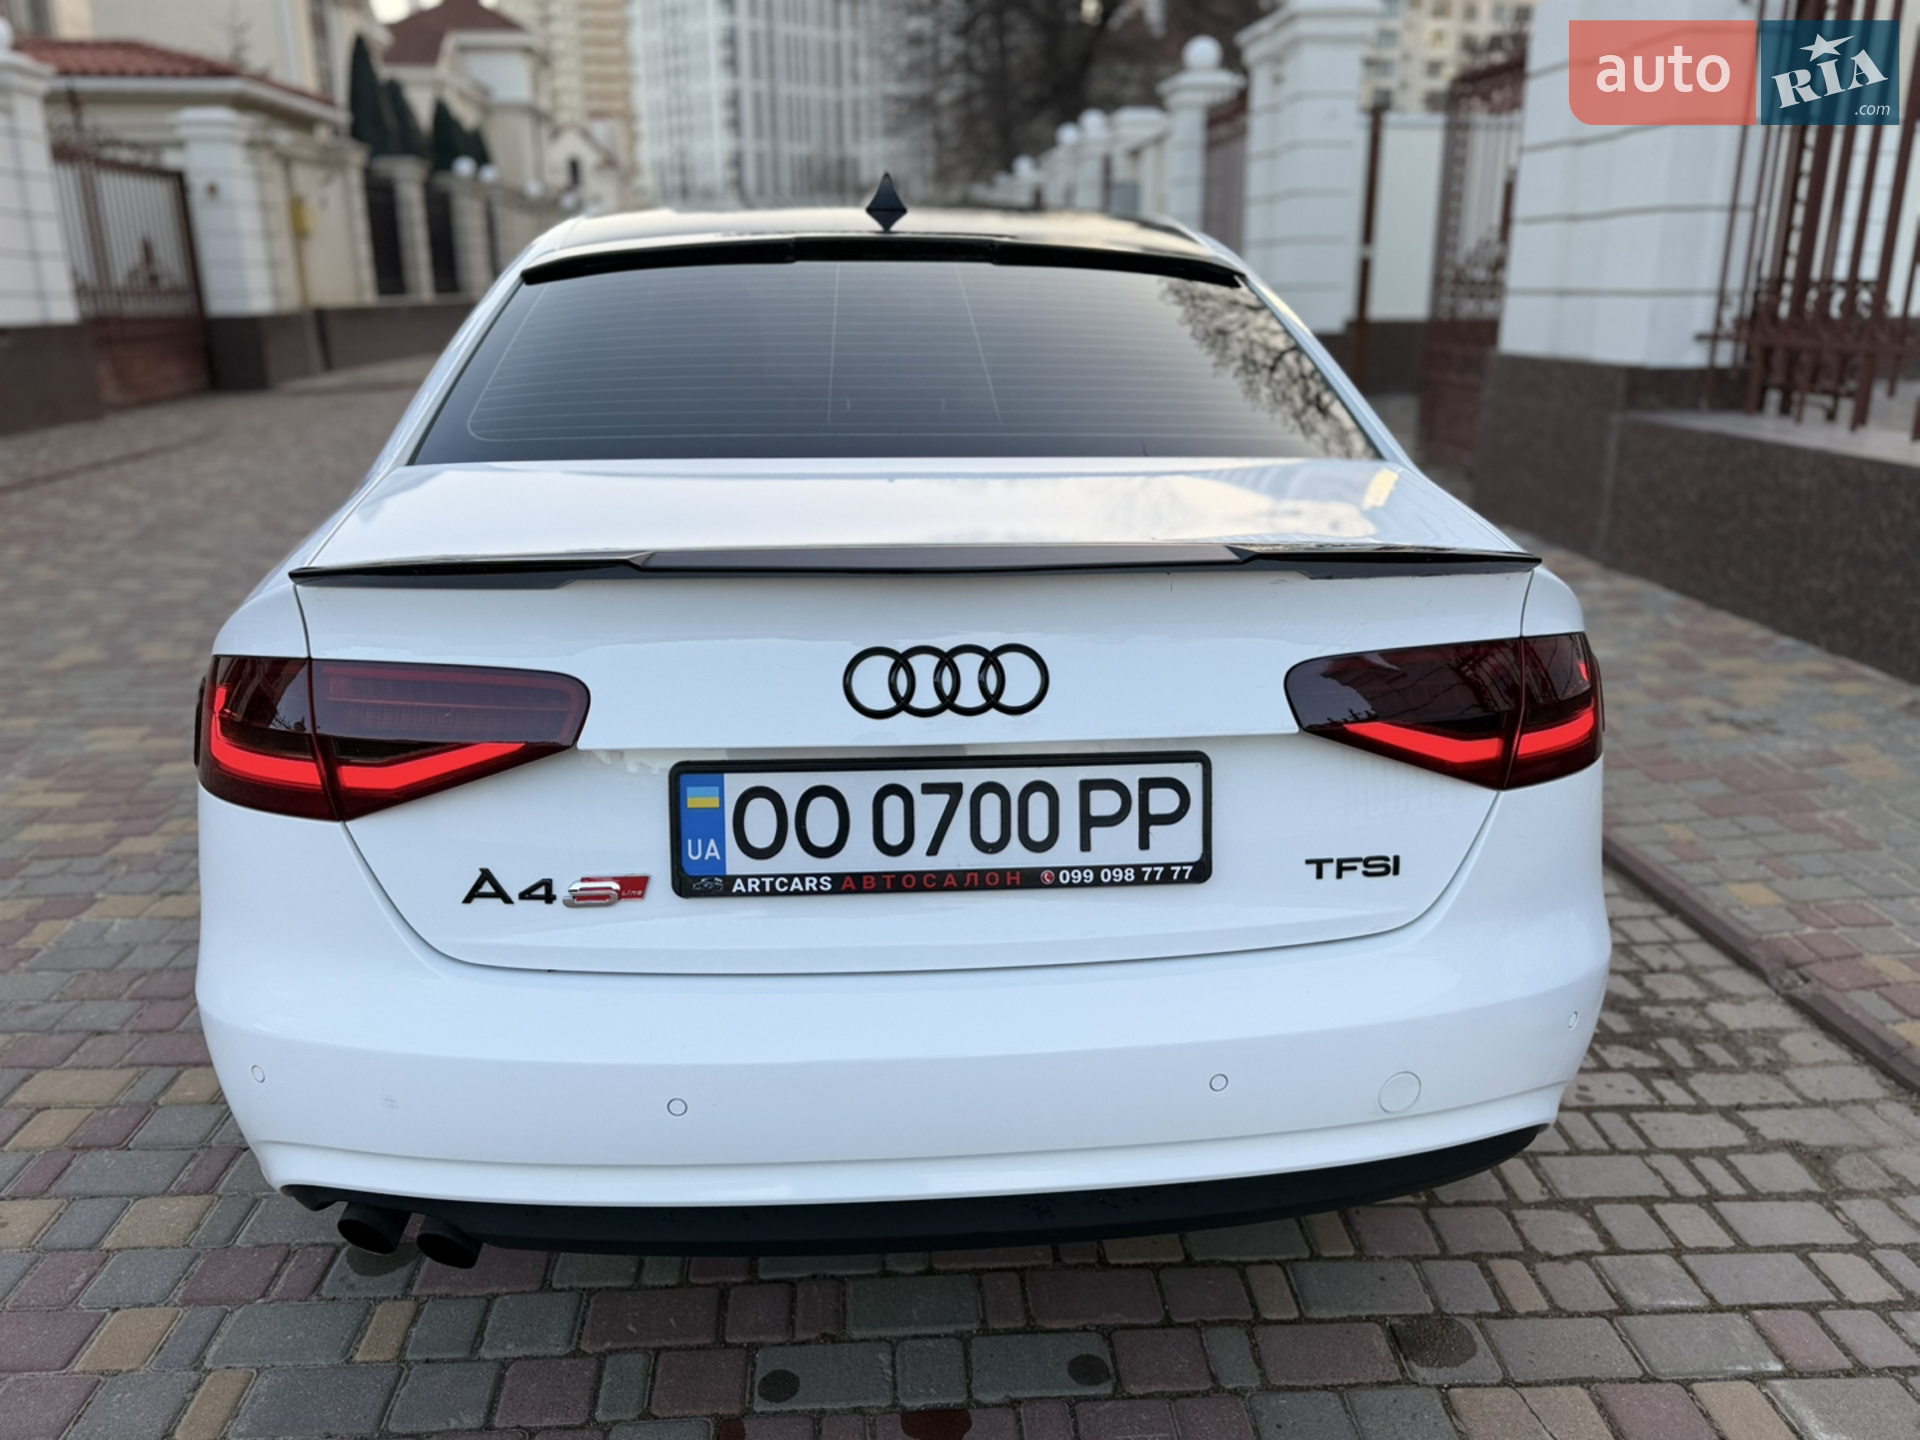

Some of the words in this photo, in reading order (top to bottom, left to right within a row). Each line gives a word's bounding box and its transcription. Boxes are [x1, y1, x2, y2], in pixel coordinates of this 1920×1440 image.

[732, 783, 851, 861] OO
[872, 779, 1060, 857] 0700
[1078, 776, 1192, 853] PP
[687, 838, 721, 861] UA
[1058, 869, 1094, 885] 099
[1100, 868, 1135, 883] 098
[1141, 866, 1164, 882] 77
[1170, 865, 1193, 880] 77
[1304, 854, 1400, 880] TFSI
[461, 867, 557, 904] A4
[731, 876, 833, 893] ARTCARS
[840, 871, 1022, 891] АВТОСАЛОН
